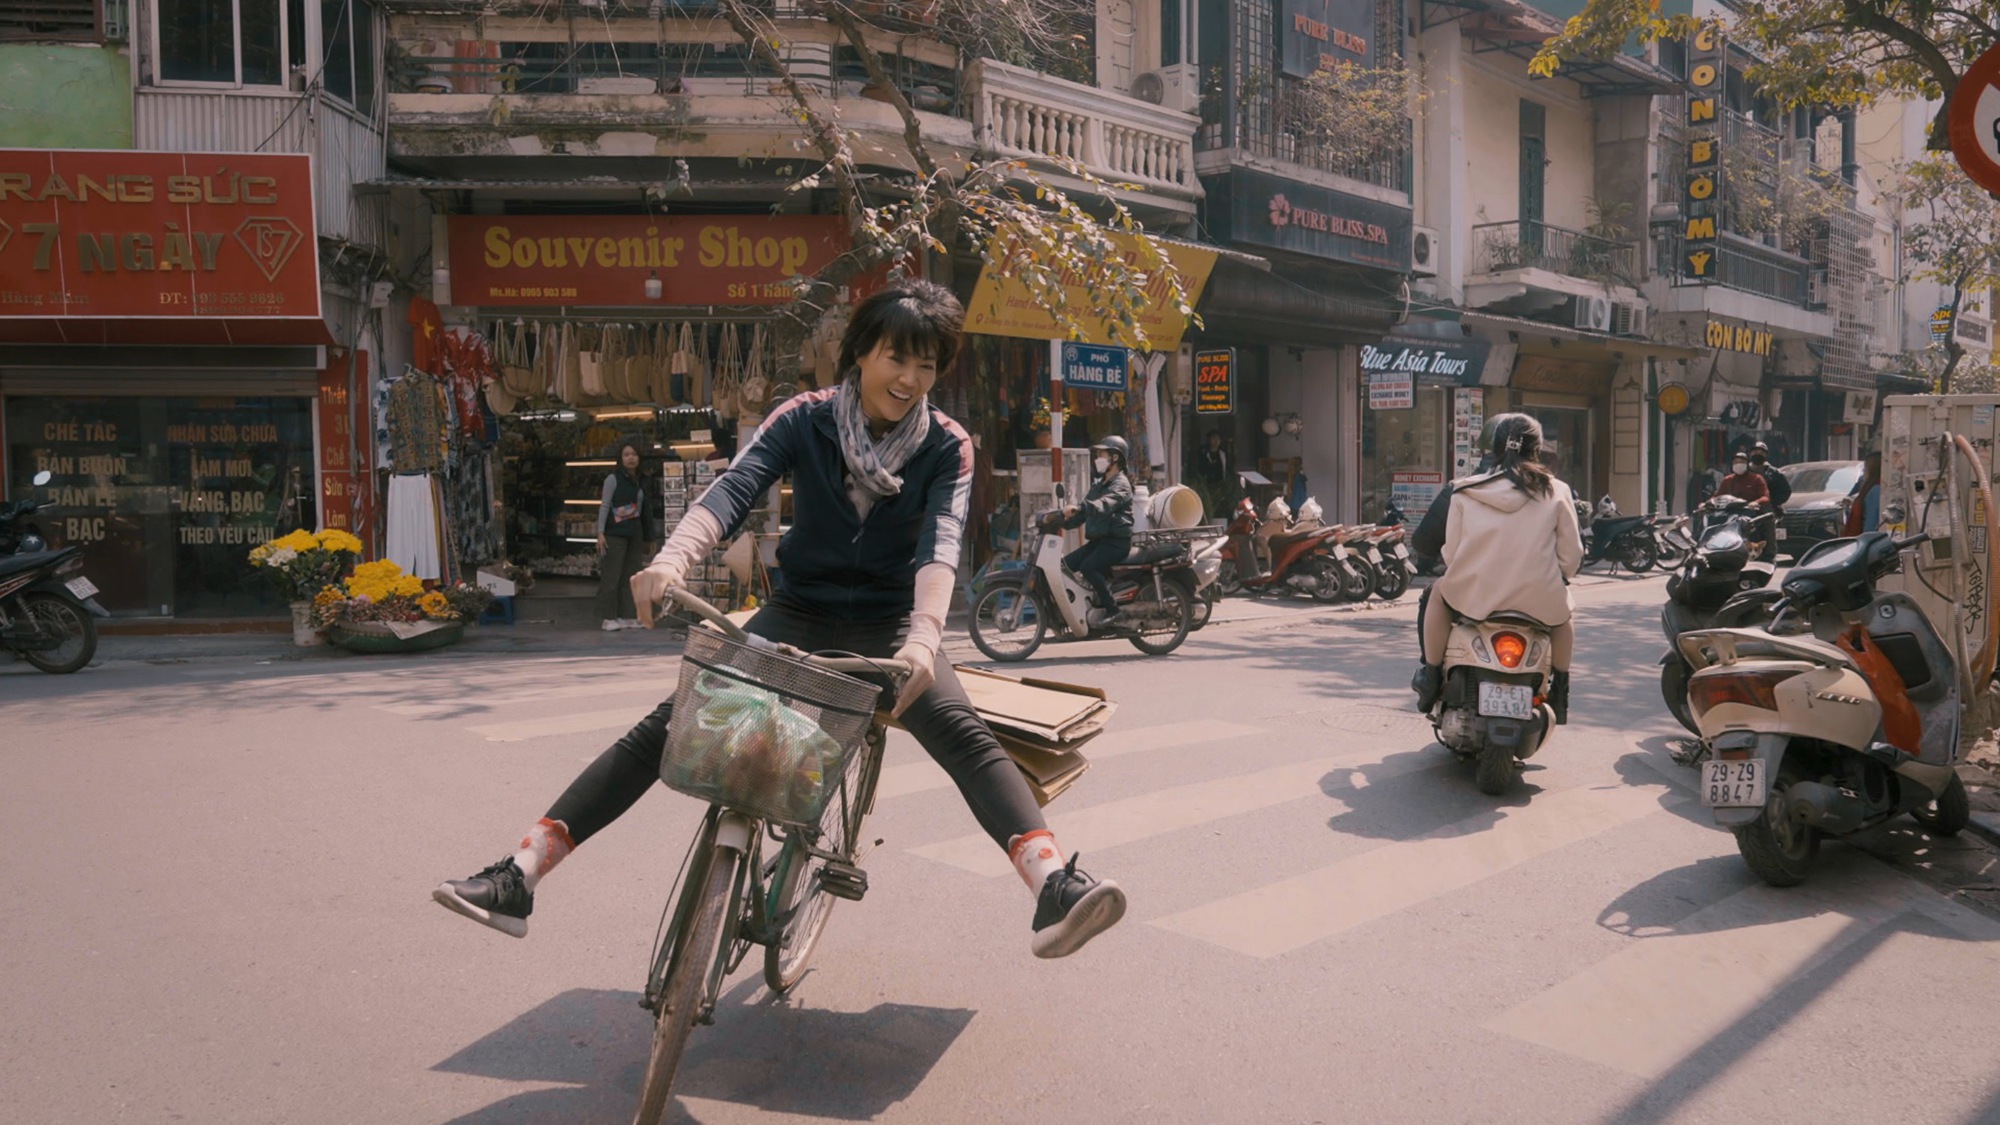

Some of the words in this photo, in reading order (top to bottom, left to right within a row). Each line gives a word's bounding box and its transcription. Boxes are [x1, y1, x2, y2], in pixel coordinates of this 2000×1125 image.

[1295, 13, 1328, 41] PURE
[1333, 27, 1367, 55] BLISS
[1293, 208, 1327, 232] PURE
[22, 223, 61, 271] 7
[76, 222, 226, 272] NGÀY
[484, 225, 685, 269] Souvenir
[698, 225, 808, 276] Shop
[160, 291, 188, 305] ĐT:
[751, 285, 758, 298] 1
[1707, 320, 1732, 350] CON
[1360, 345, 1393, 370] Blue
[1391, 348, 1429, 372] Asia
[1430, 351, 1469, 375] Tours
[1069, 361, 1104, 383] HÀNG
[1198, 365, 1228, 383] SPA
[1413, 474, 1440, 482] EXCHANGE
[180, 526, 214, 545] THEO
[1711, 763, 1755, 783] 29-Z9
[1710, 784, 1755, 803] 8847
